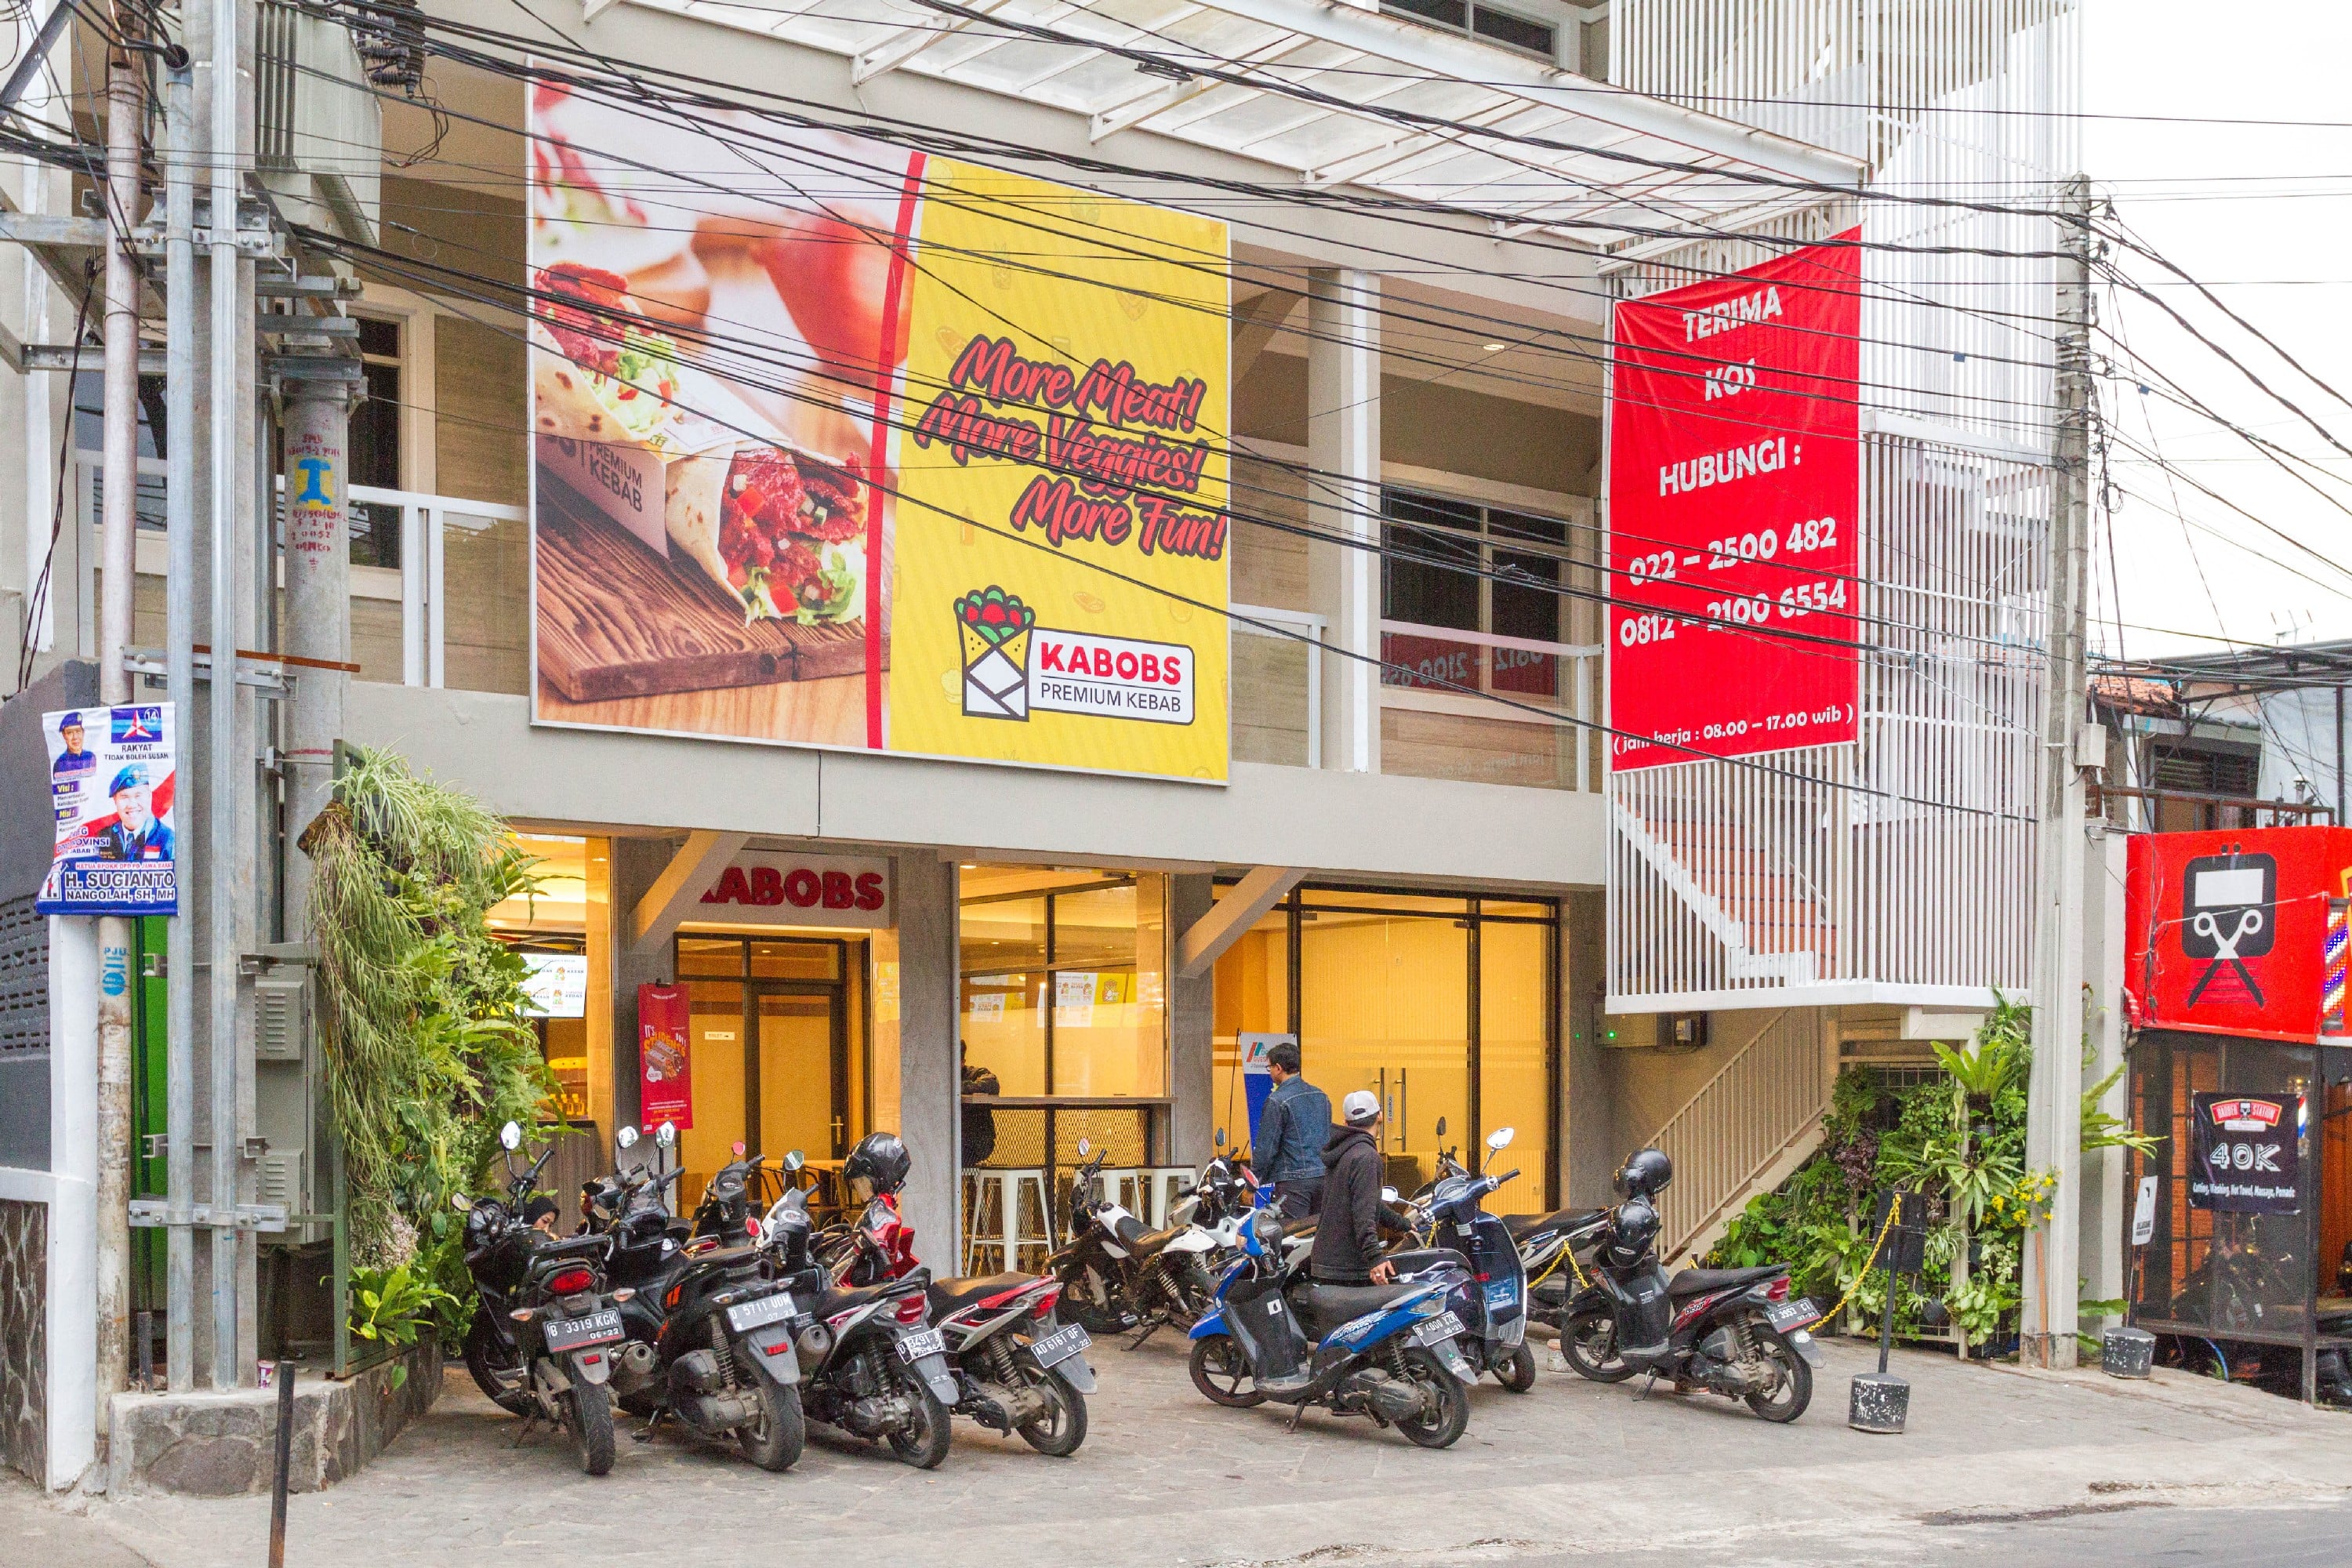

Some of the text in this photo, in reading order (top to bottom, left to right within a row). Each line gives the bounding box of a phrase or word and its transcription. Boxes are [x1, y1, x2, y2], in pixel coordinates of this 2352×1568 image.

[1682, 286, 1783, 343] TERIMA
[949, 335, 1207, 432] More Meat!
[589, 441, 642, 488] PREMIUM
[913, 392, 1210, 501] More Veggies!
[589, 454, 643, 512] KEBAB
[1659, 437, 1786, 496] HUBUNGI
[1010, 474, 1228, 561] More Fun!
[1628, 550, 1676, 586] 022
[1708, 529, 1778, 571] 2500
[1786, 517, 1837, 553] 482
[1620, 612, 1675, 647] 0812
[1707, 593, 1771, 631] 2100
[1779, 578, 1846, 618] 6554
[1040, 641, 1181, 685] KABOBS
[146, 711, 158, 721] 14
[1040, 682, 1181, 713] PREMIUM KEBAB
[1703, 719, 1748, 739] 08.00
[1766, 711, 1807, 731] 17.00
[1812, 705, 1842, 724] wib
[66, 872, 175, 887] H. SUGIANTO
[67, 889, 173, 901] NANGOLAH, SH, MH
[700, 866, 885, 911] ABOBS
[2252, 1102, 2277, 1120] STATION
[2209, 1142, 2281, 1172] 40K
[550, 1324, 558, 1337] B
[564, 1318, 593, 1334] 3319
[742, 1301, 768, 1316] 5711
[1425, 1319, 1443, 1331] 4000
[1035, 1344, 1047, 1356] AD
[1046, 1334, 1067, 1350] 6161
